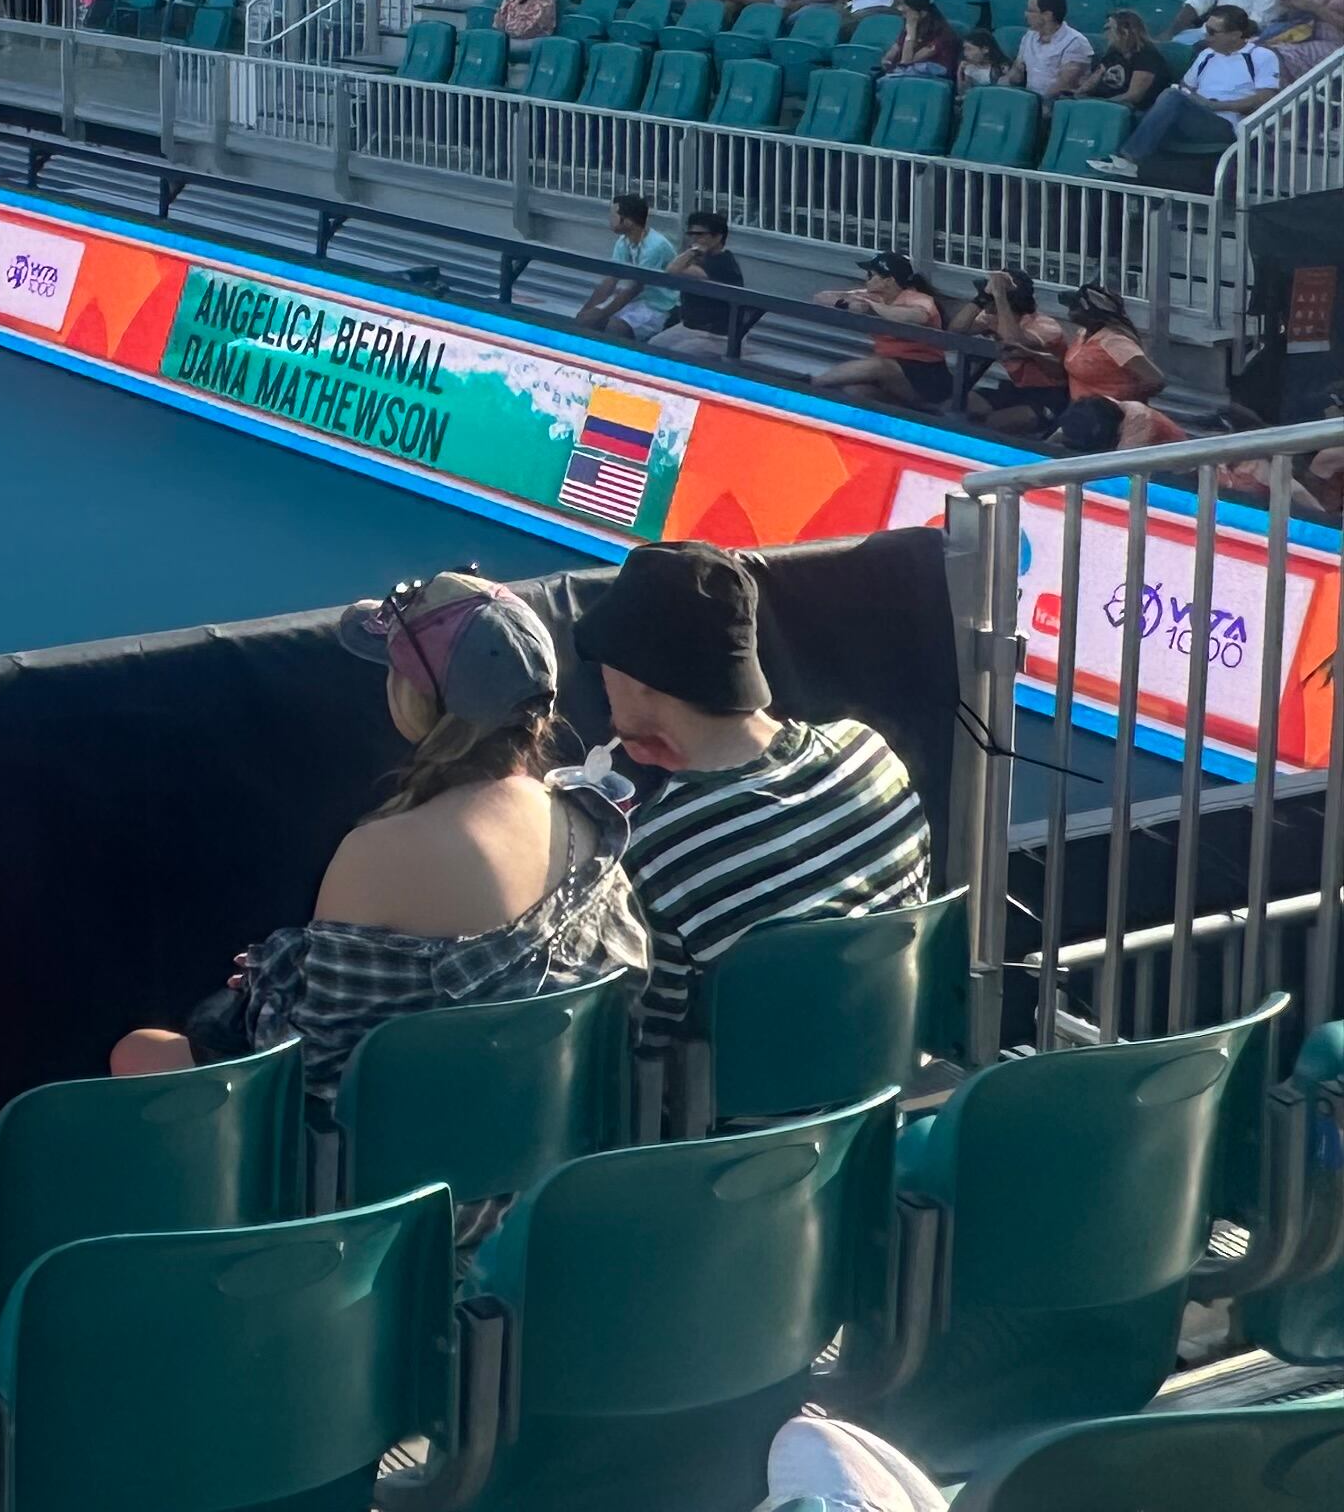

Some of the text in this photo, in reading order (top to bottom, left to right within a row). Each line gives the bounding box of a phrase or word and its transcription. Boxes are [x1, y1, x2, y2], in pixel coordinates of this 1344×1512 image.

[194, 279, 446, 395] ANGELICA BERNAL
[178, 334, 451, 463] DANA MATHEWSON
